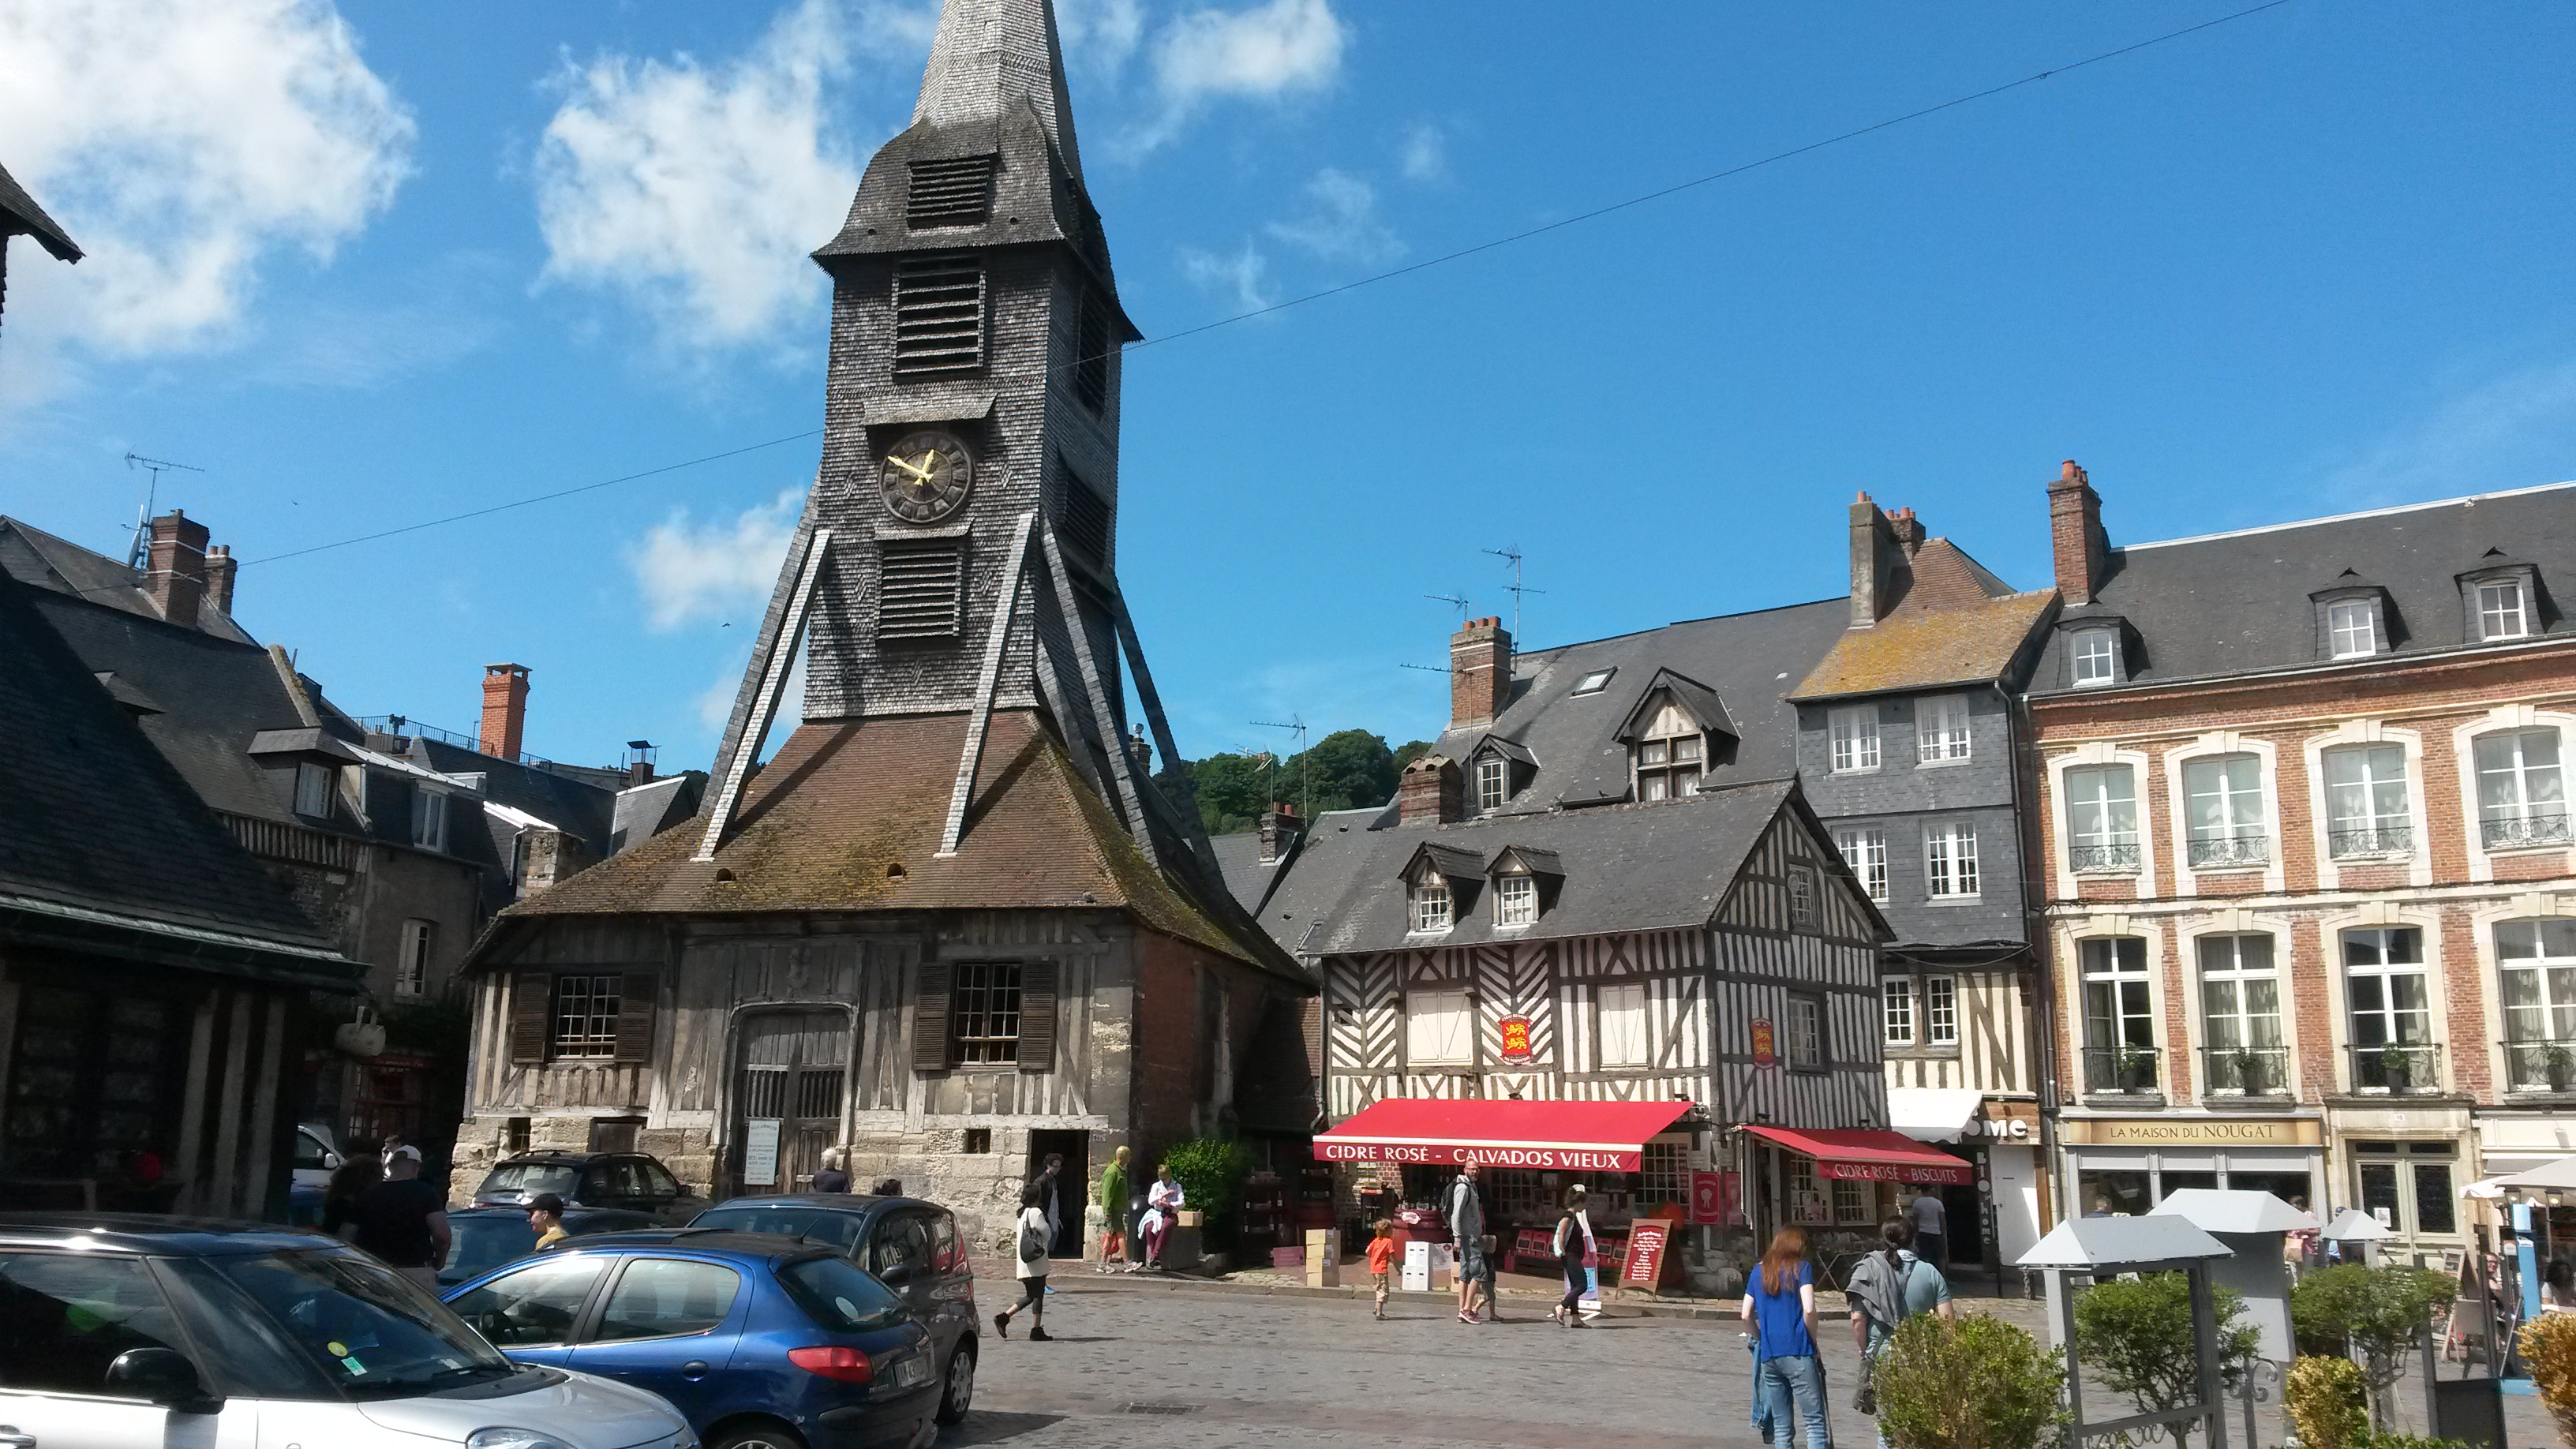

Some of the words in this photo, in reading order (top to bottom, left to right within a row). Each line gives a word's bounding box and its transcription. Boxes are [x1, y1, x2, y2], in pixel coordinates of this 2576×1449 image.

[2110, 1127, 2126, 1138] LA
[2130, 1127, 2178, 1138] MAISON
[2183, 1127, 2199, 1138] DU
[2203, 1125, 2275, 1138] NOUGAT
[1326, 1145, 1377, 1159] CIDRE
[1384, 1146, 1429, 1162] ROSÉ
[1453, 1148, 1554, 1166] CALVADOS
[1559, 1151, 1621, 1169] VIEUX
[1835, 1163, 1870, 1178] CIDRE
[1871, 1164, 1900, 1181] ROSÉ
[1911, 1168, 1958, 1183] BISCUITS
